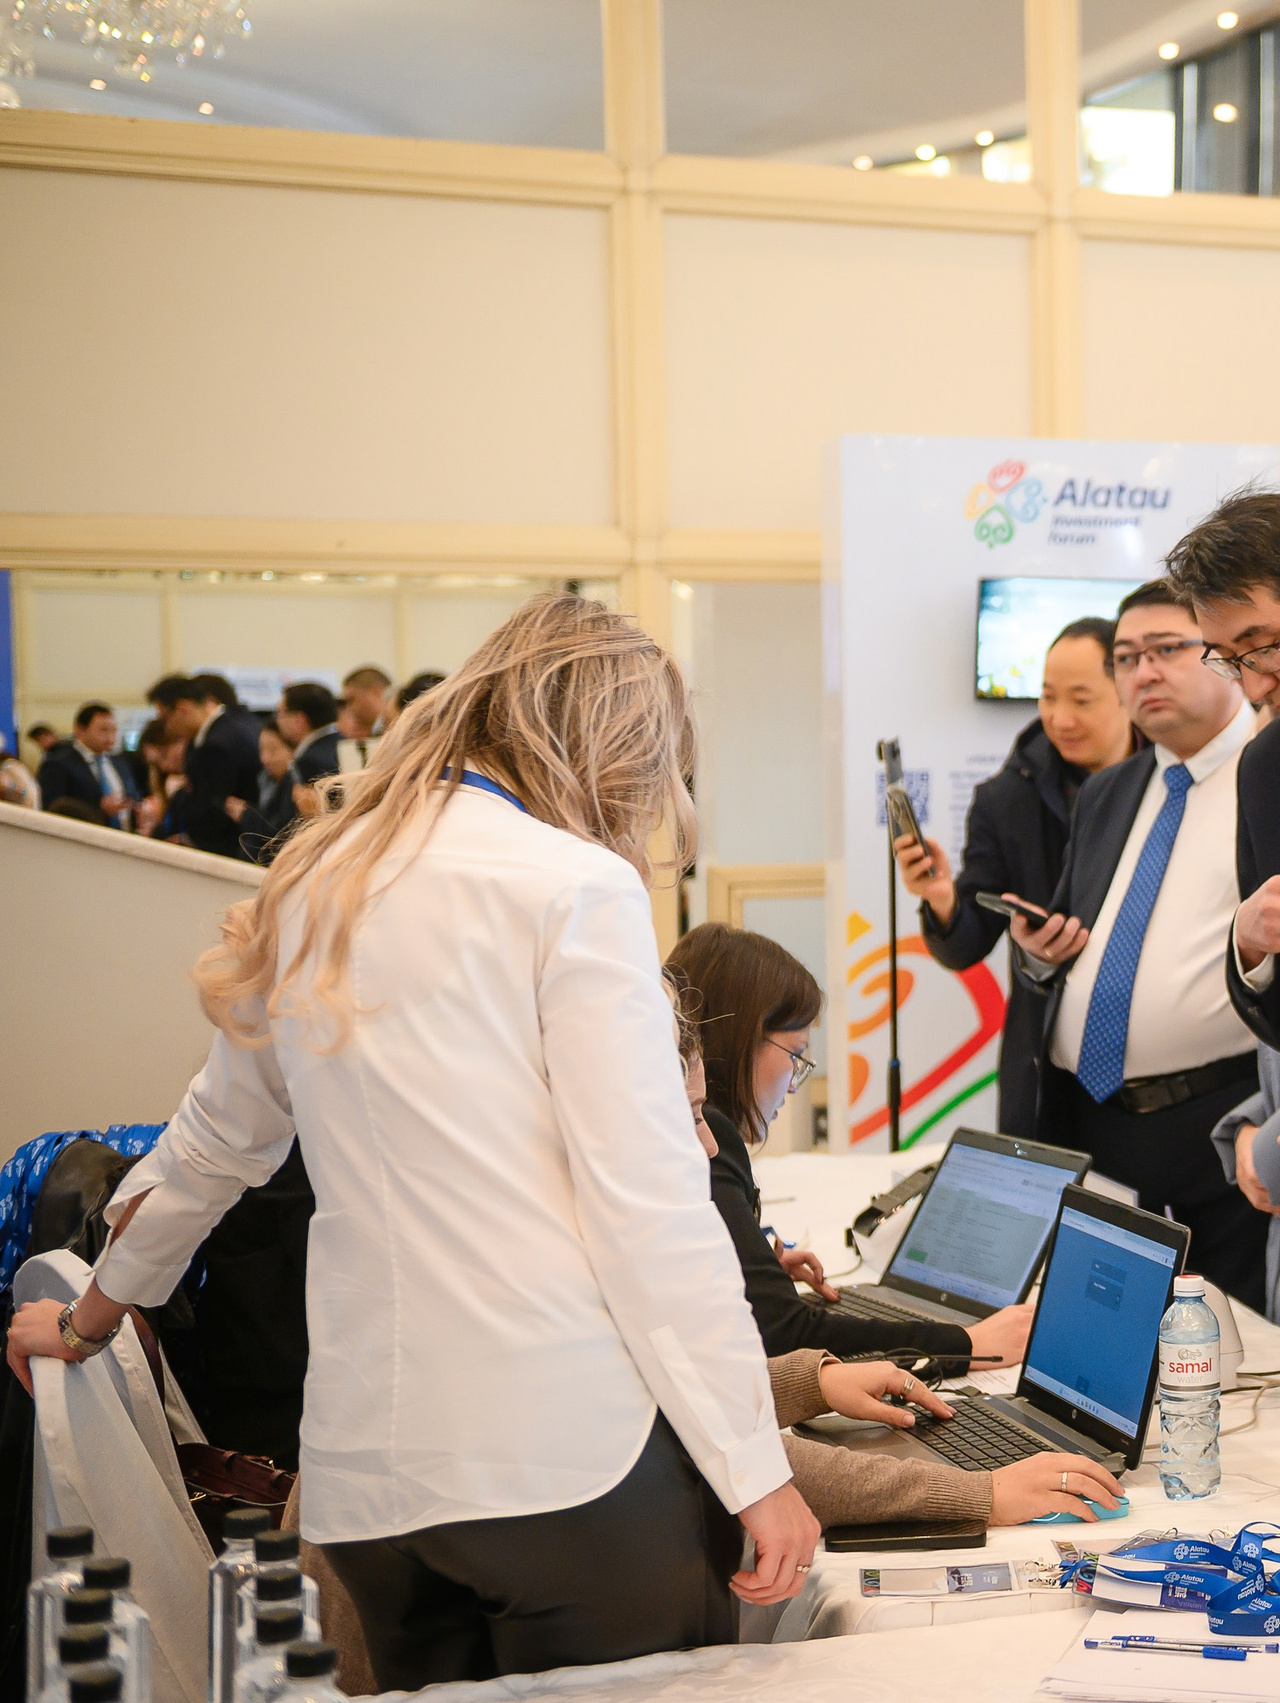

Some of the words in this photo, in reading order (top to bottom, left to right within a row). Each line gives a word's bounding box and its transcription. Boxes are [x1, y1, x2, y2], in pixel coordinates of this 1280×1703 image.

[1053, 479, 1172, 510] Alatau
[1168, 1357, 1212, 1374] samal
[1178, 1376, 1202, 1384] water
[1189, 1545, 1210, 1553] Alatau
[1181, 1574, 1204, 1583] Alatau
[1209, 1615, 1224, 1625] latau
